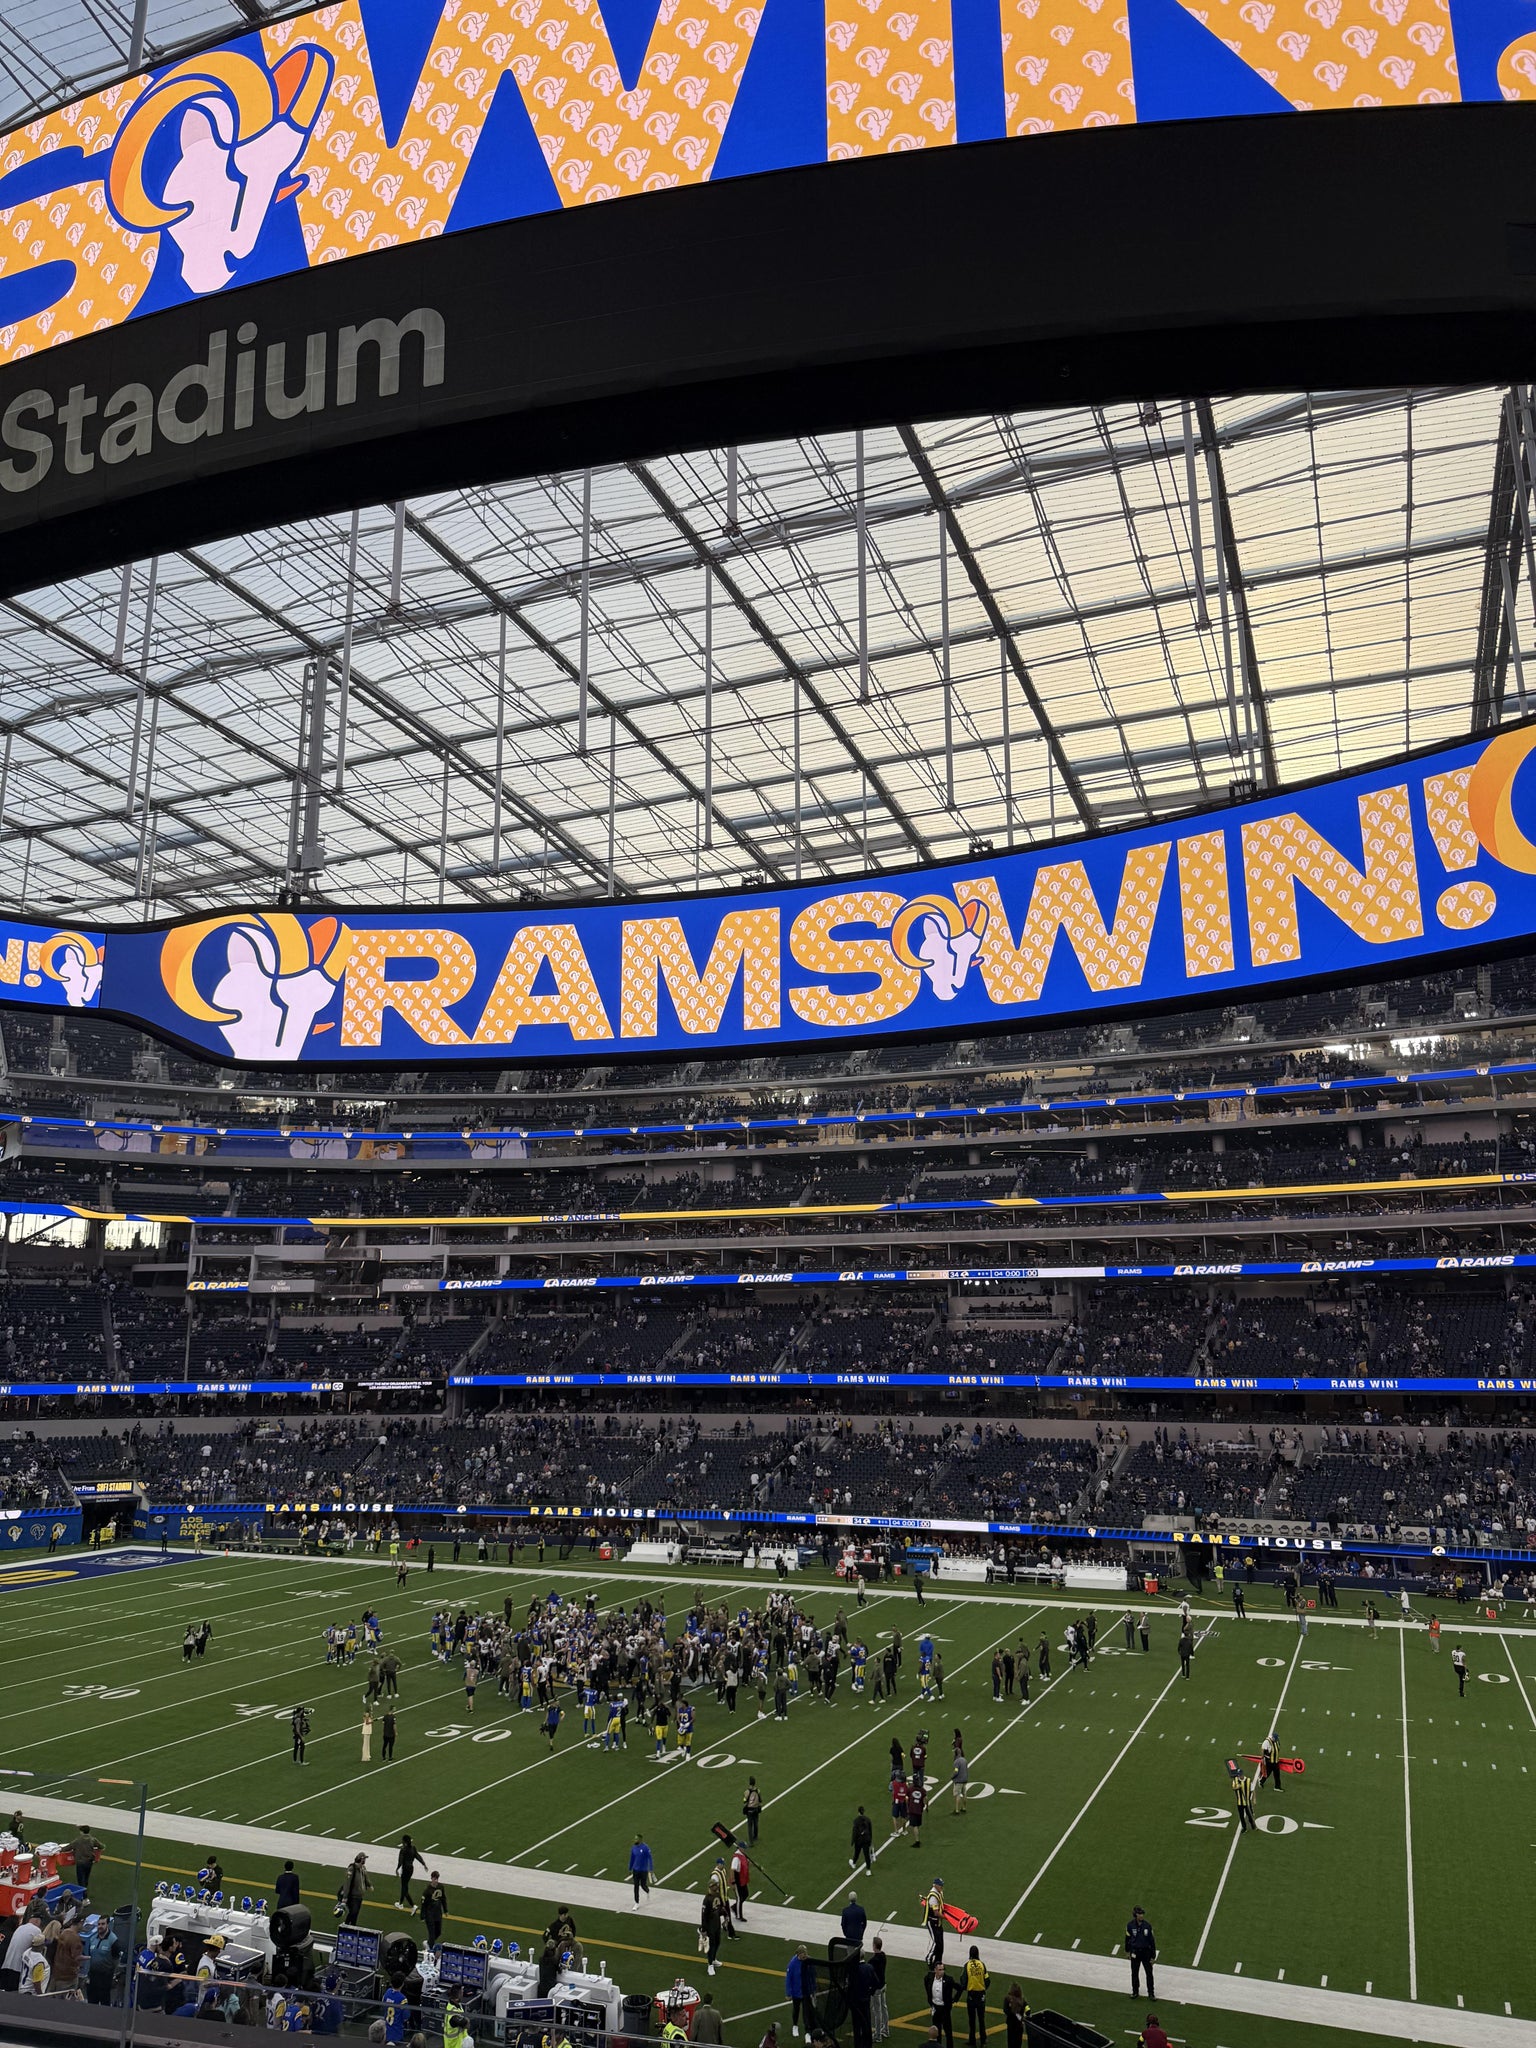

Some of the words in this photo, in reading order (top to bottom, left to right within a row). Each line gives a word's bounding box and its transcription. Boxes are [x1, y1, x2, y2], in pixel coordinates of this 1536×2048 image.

[0, 307, 447, 494] Stadium
[341, 890, 921, 1047] RAMS
[953, 764, 1496, 1004] WIN!
[1461, 1256, 1515, 1267] RAMS
[1195, 1265, 1242, 1274] RAMS
[561, 1278, 597, 1286] RAMS
[755, 1273, 793, 1282] RAMS
[1102, 1378, 1127, 1386] WIN!
[1370, 1380, 1398, 1388] WIN!
[77, 1385, 106, 1393] RAMS
[266, 1504, 320, 1512] RAMS
[332, 1504, 394, 1512] HOUSE
[530, 1507, 582, 1516] RAMS
[594, 1509, 655, 1518] HOUSE
[1173, 1533, 1240, 1545] RAMS
[1258, 1536, 1342, 1550] HOUSE
[425, 1724, 512, 1743] 50
[1185, 1806, 1298, 1835] 20
[40, 1858, 47, 1867] G
